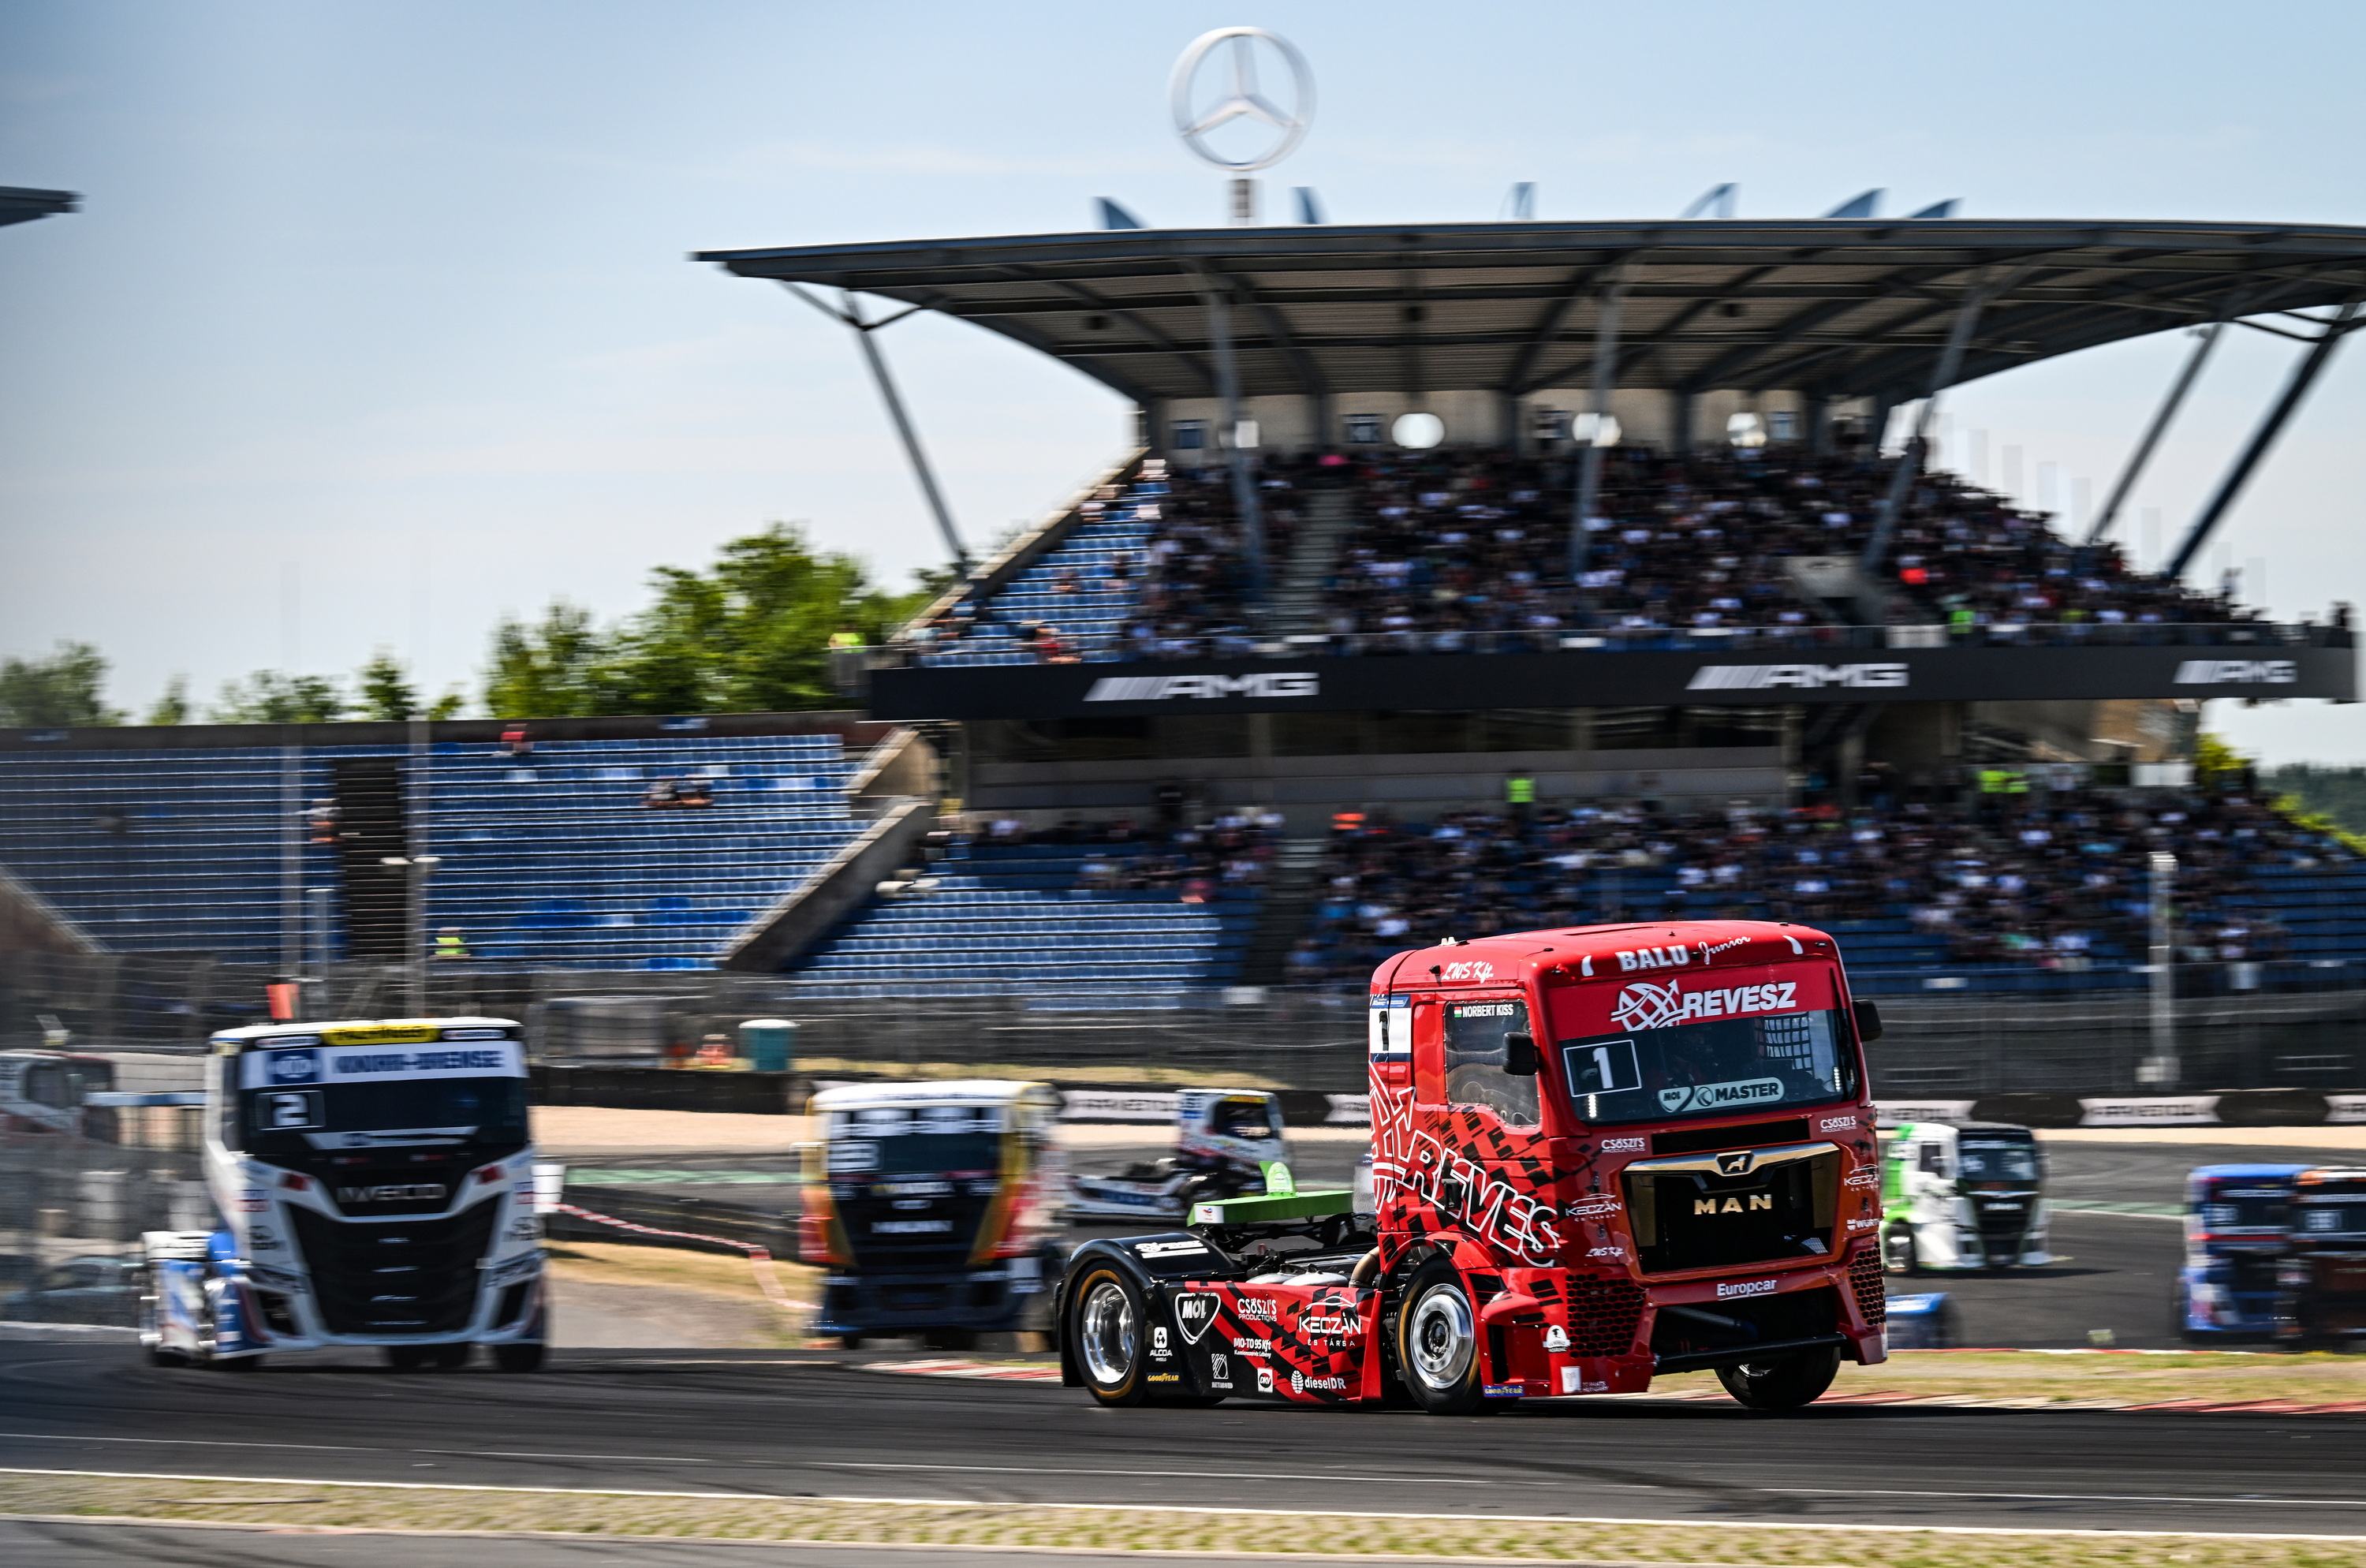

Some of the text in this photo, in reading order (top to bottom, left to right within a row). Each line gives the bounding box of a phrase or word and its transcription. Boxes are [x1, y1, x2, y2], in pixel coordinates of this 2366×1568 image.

[1155, 673, 1320, 700] AMG
[1760, 663, 1909, 689] AMG
[1615, 935, 1752, 972] BALU Junior
[1463, 1004, 1514, 1018] NORBERT KISS
[1681, 982, 1797, 1019] REVESZ
[1379, 1010, 1389, 1051] 1
[1592, 1047, 1614, 1089] 1
[1663, 1082, 1779, 1103] MOL MASTER
[271, 1094, 310, 1126] 2
[1694, 1194, 1772, 1215] MAN
[1717, 1279, 1777, 1296] Europcar
[1182, 1300, 1207, 1319] MOL
[1148, 1372, 1179, 1382] GOODYEAR
[1304, 1376, 1346, 1390] dieselDR
